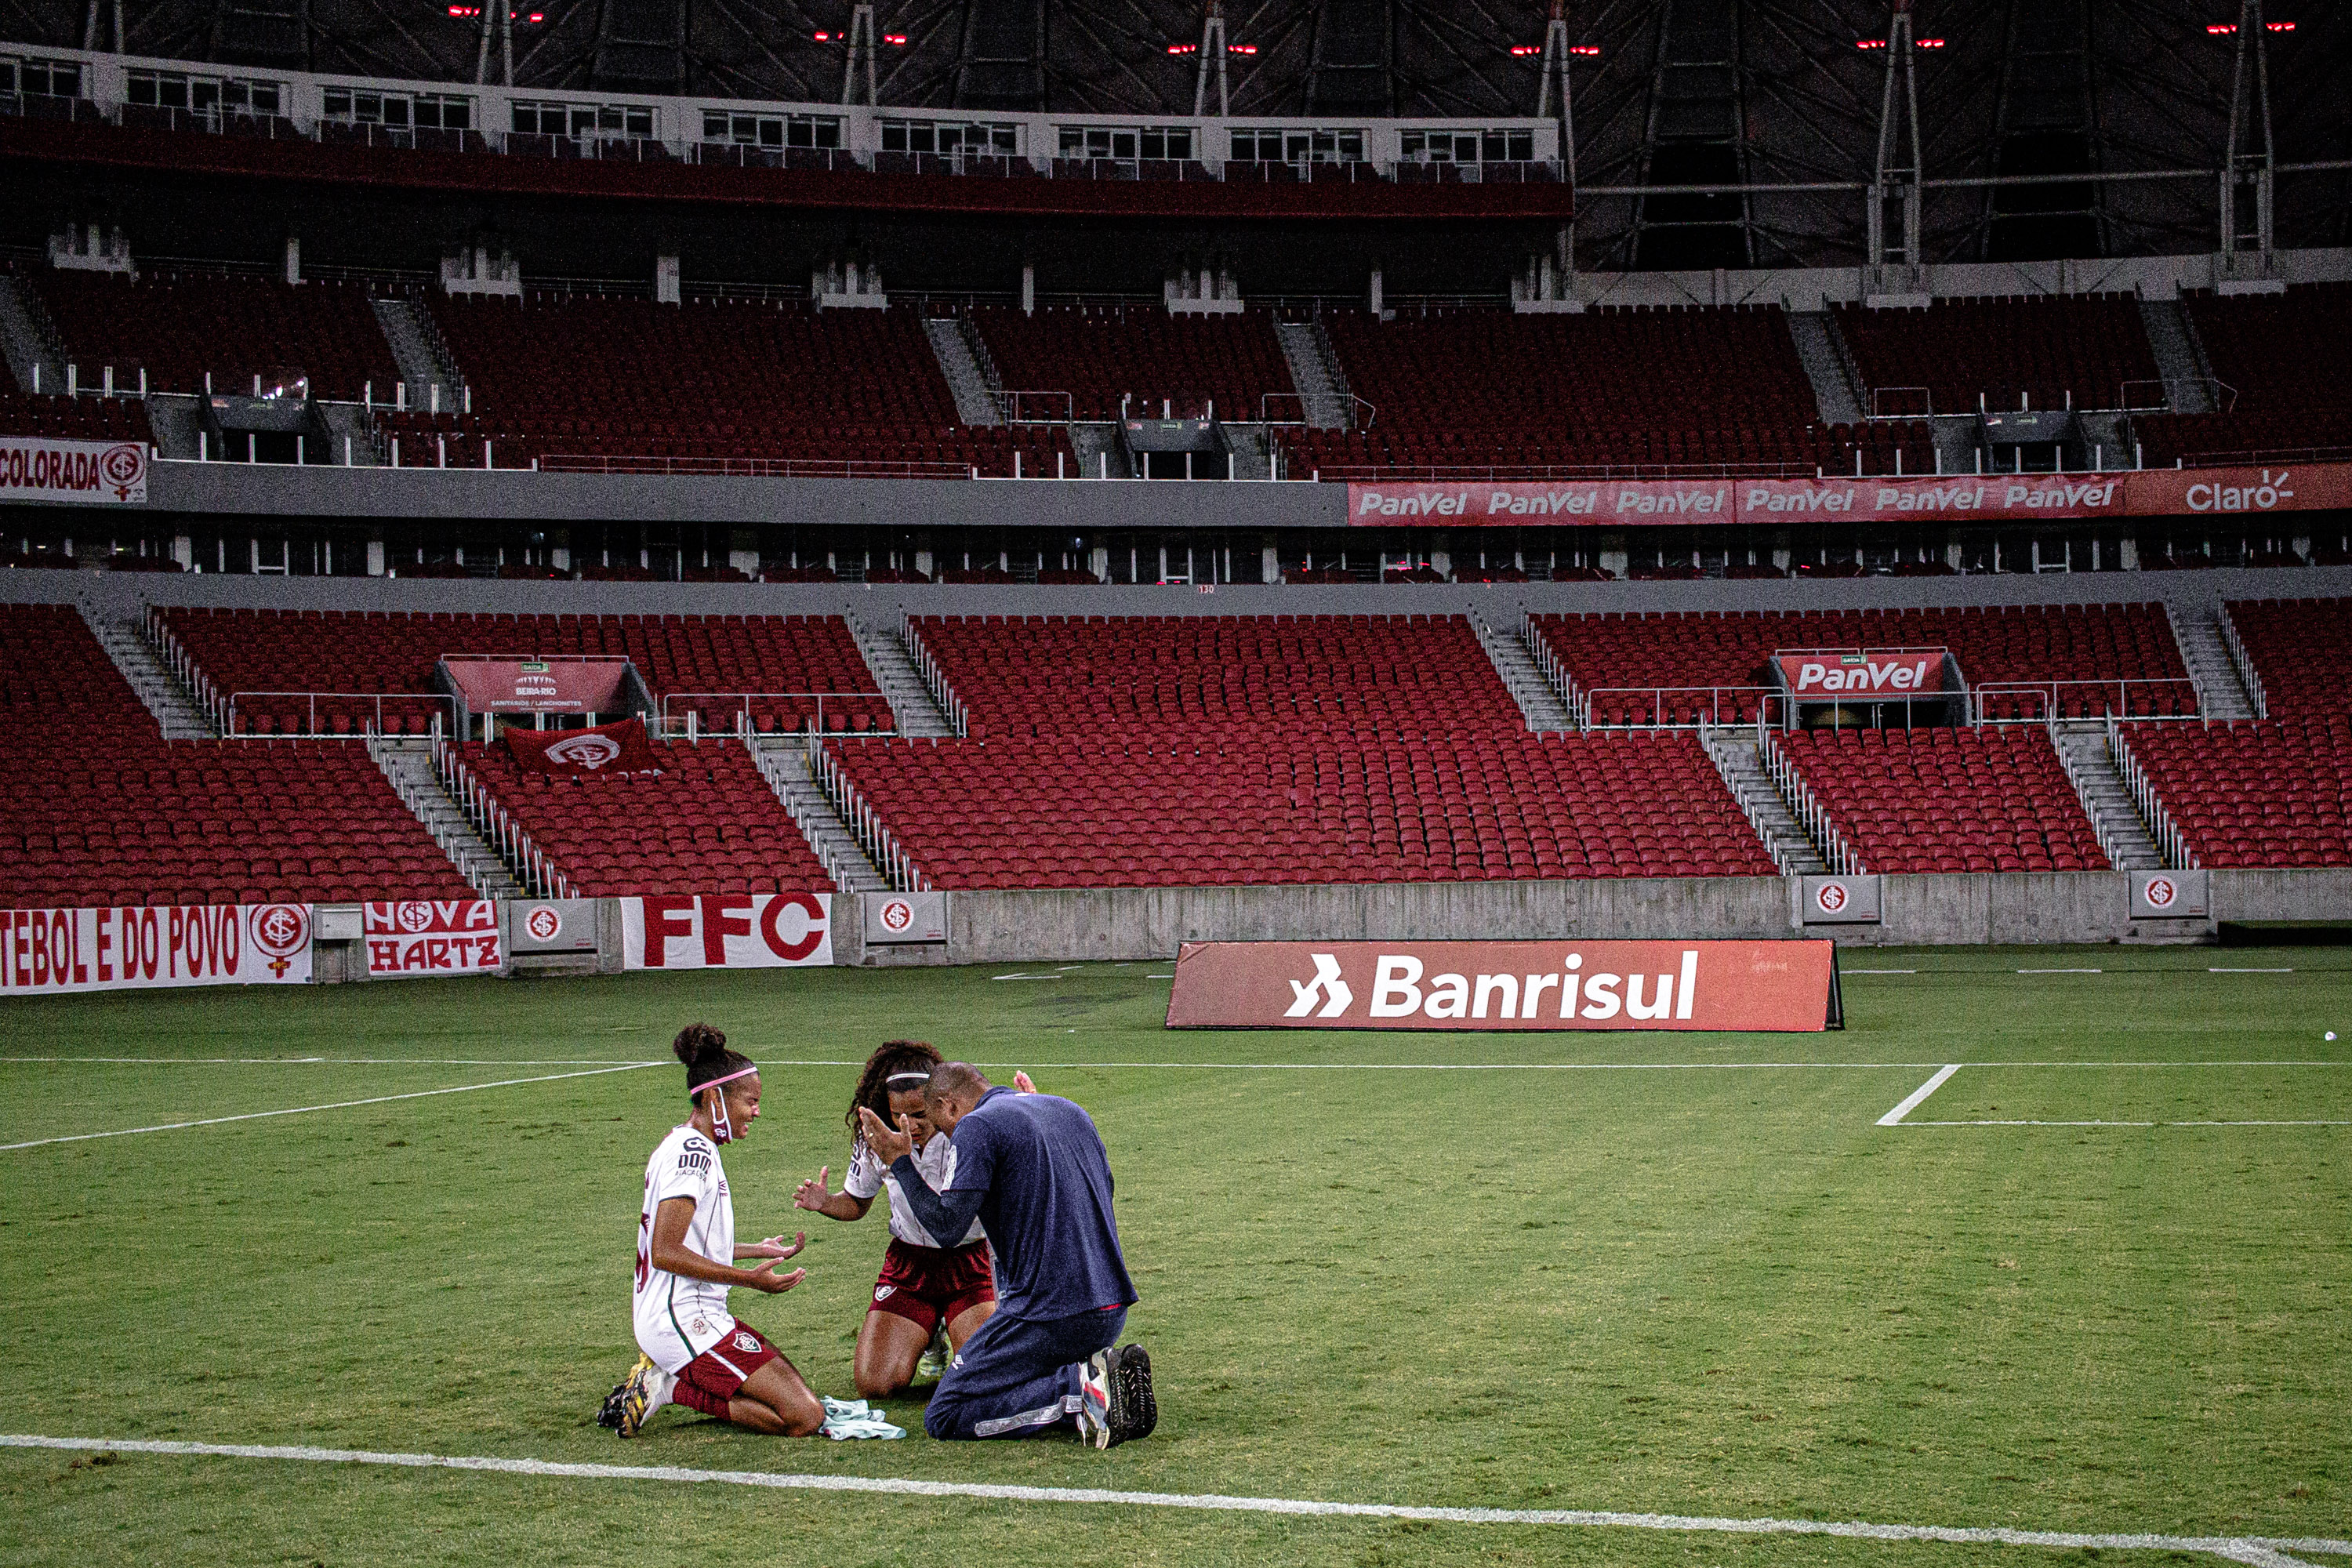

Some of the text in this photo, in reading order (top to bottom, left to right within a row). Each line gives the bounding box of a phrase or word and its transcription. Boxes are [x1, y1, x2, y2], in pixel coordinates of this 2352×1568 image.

[0, 448, 101, 491] COLORADA
[1358, 492, 1467, 516] PanVel
[1488, 491, 1597, 514] PanVel
[1616, 489, 1725, 514] PanVel
[1746, 488, 1854, 512] PanVel
[1875, 487, 1984, 511] PanVel
[2005, 483, 2114, 509] PanVel
[2187, 483, 2278, 510] Claro
[1798, 661, 1926, 691] PanVel
[365, 901, 495, 932] NOVA
[96, 907, 113, 982] E
[122, 906, 159, 980] DO
[169, 906, 240, 978] POVO
[643, 894, 826, 967] FFC
[368, 935, 500, 971] HARTZ
[1370, 950, 1699, 1020] Banrisul
[678, 1152, 712, 1174] DOM
